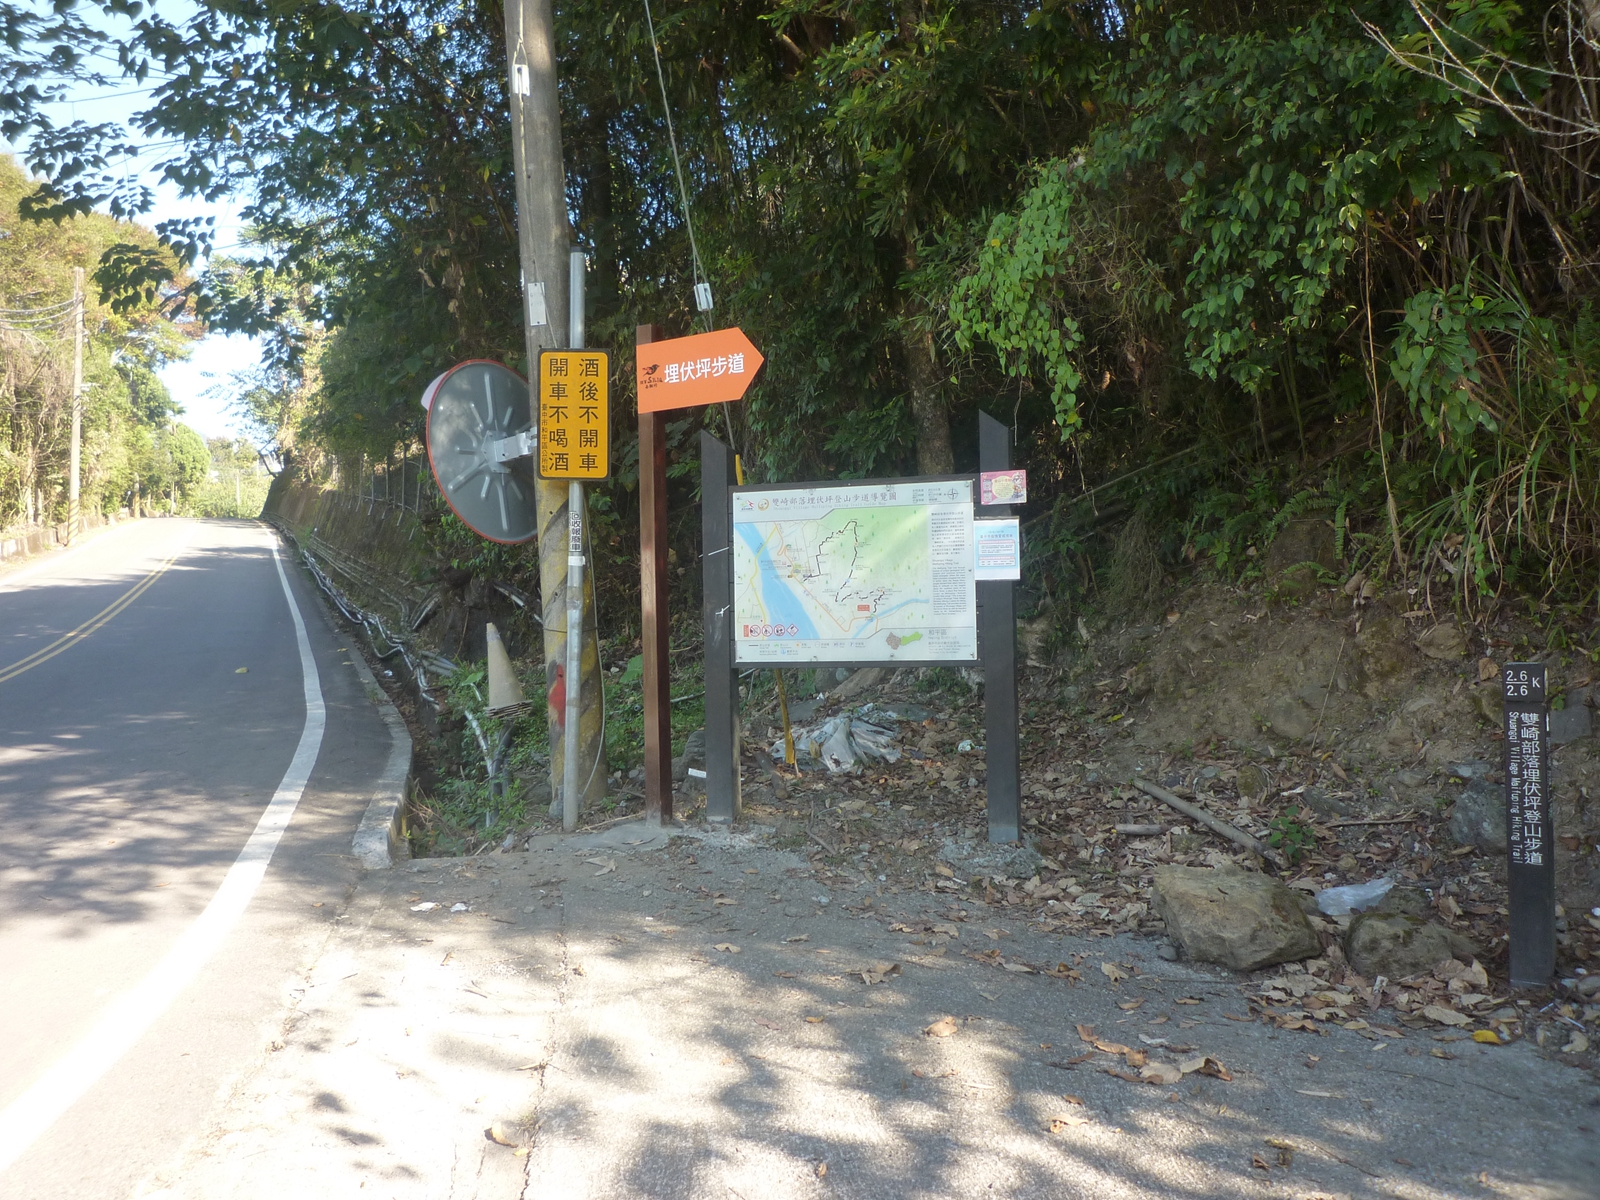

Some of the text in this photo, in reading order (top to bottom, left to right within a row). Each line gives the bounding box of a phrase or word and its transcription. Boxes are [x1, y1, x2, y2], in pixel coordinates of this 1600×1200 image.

[664, 352, 745, 383] 埋伏坪步道
[549, 358, 569, 472] 開車不喝酒
[579, 358, 599, 472] 酒後不開車
[1506, 670, 1528, 681] 2.6
[1532, 677, 1541, 688] K
[1507, 685, 1528, 696] 2.6
[1509, 746, 1521, 775] Village
[1520, 712, 1543, 866] 雙崎部落埋伏坪登山步道
[1511, 816, 1523, 841] Hiking
[1512, 844, 1524, 864] Trail
